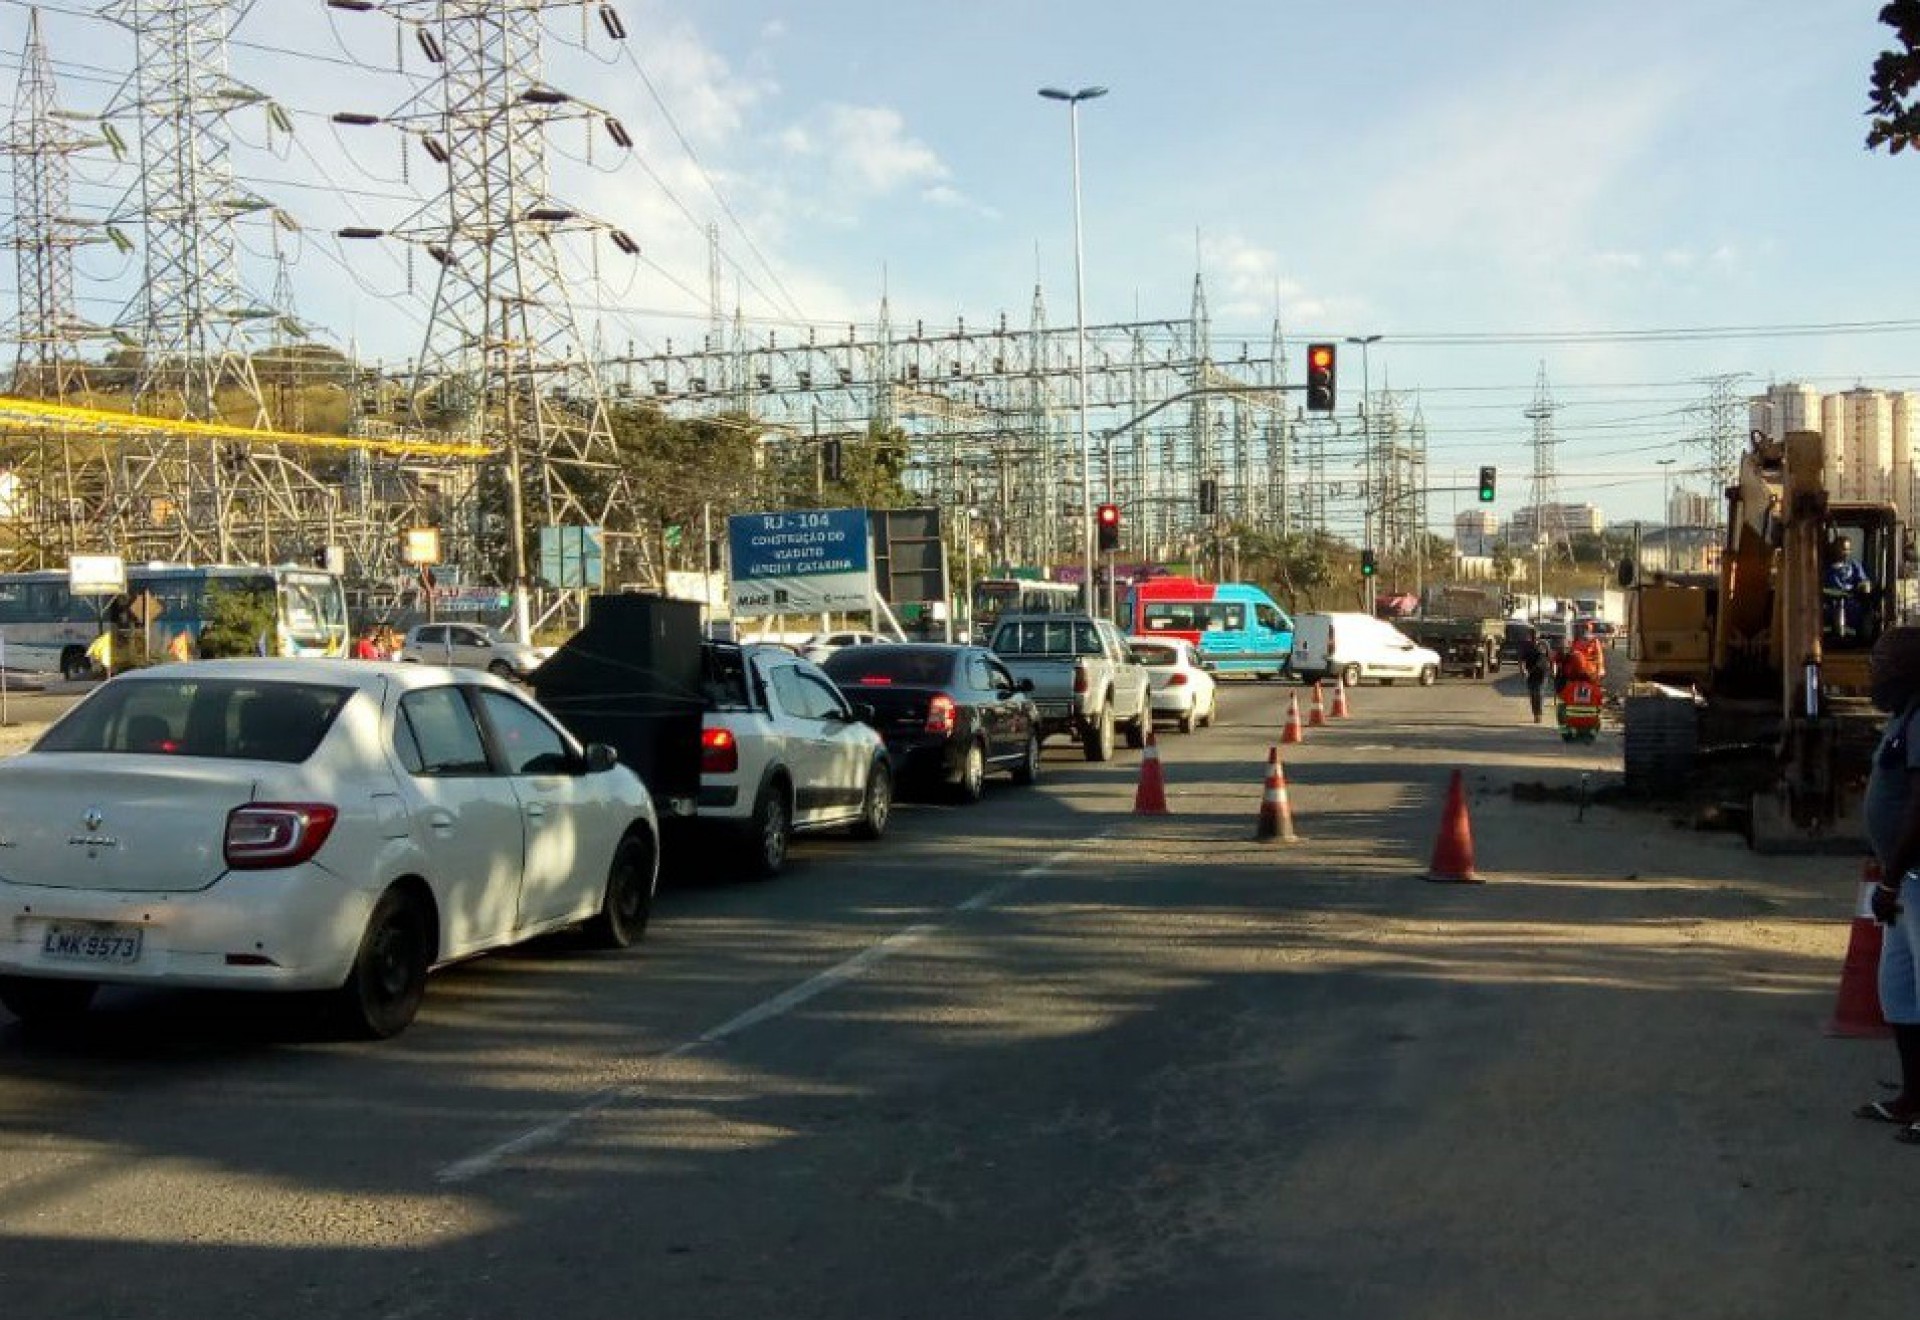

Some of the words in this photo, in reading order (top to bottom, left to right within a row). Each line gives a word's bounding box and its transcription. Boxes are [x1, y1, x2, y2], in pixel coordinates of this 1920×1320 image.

[763, 514, 783, 529] RJ
[799, 513, 829, 528] 104
[827, 531, 845, 542] DO
